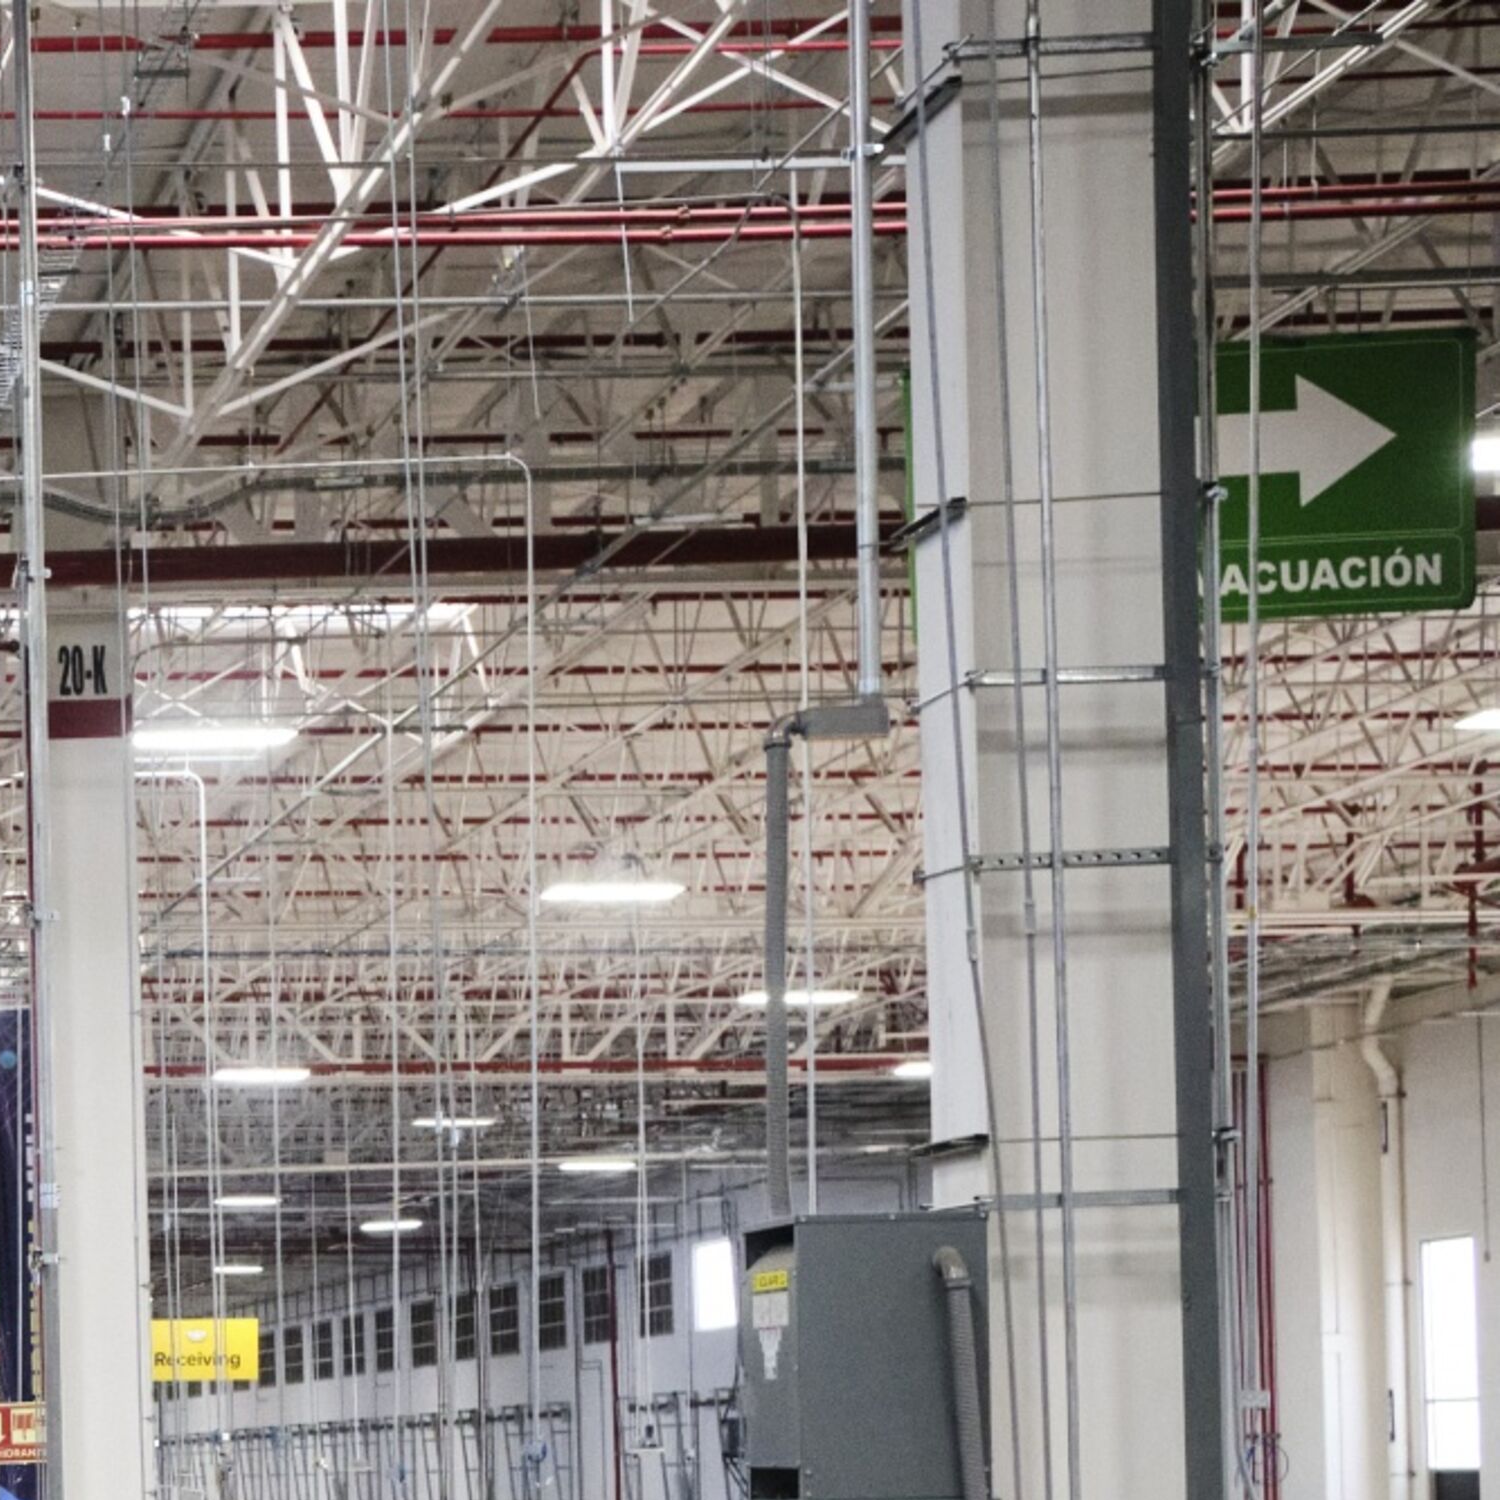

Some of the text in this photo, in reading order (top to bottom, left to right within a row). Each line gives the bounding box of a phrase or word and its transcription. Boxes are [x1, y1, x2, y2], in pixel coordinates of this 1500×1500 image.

[1198, 546, 1443, 597] ACUACIÓN
[58, 645, 107, 696] 20-K
[154, 1351, 241, 1369] Receiving
